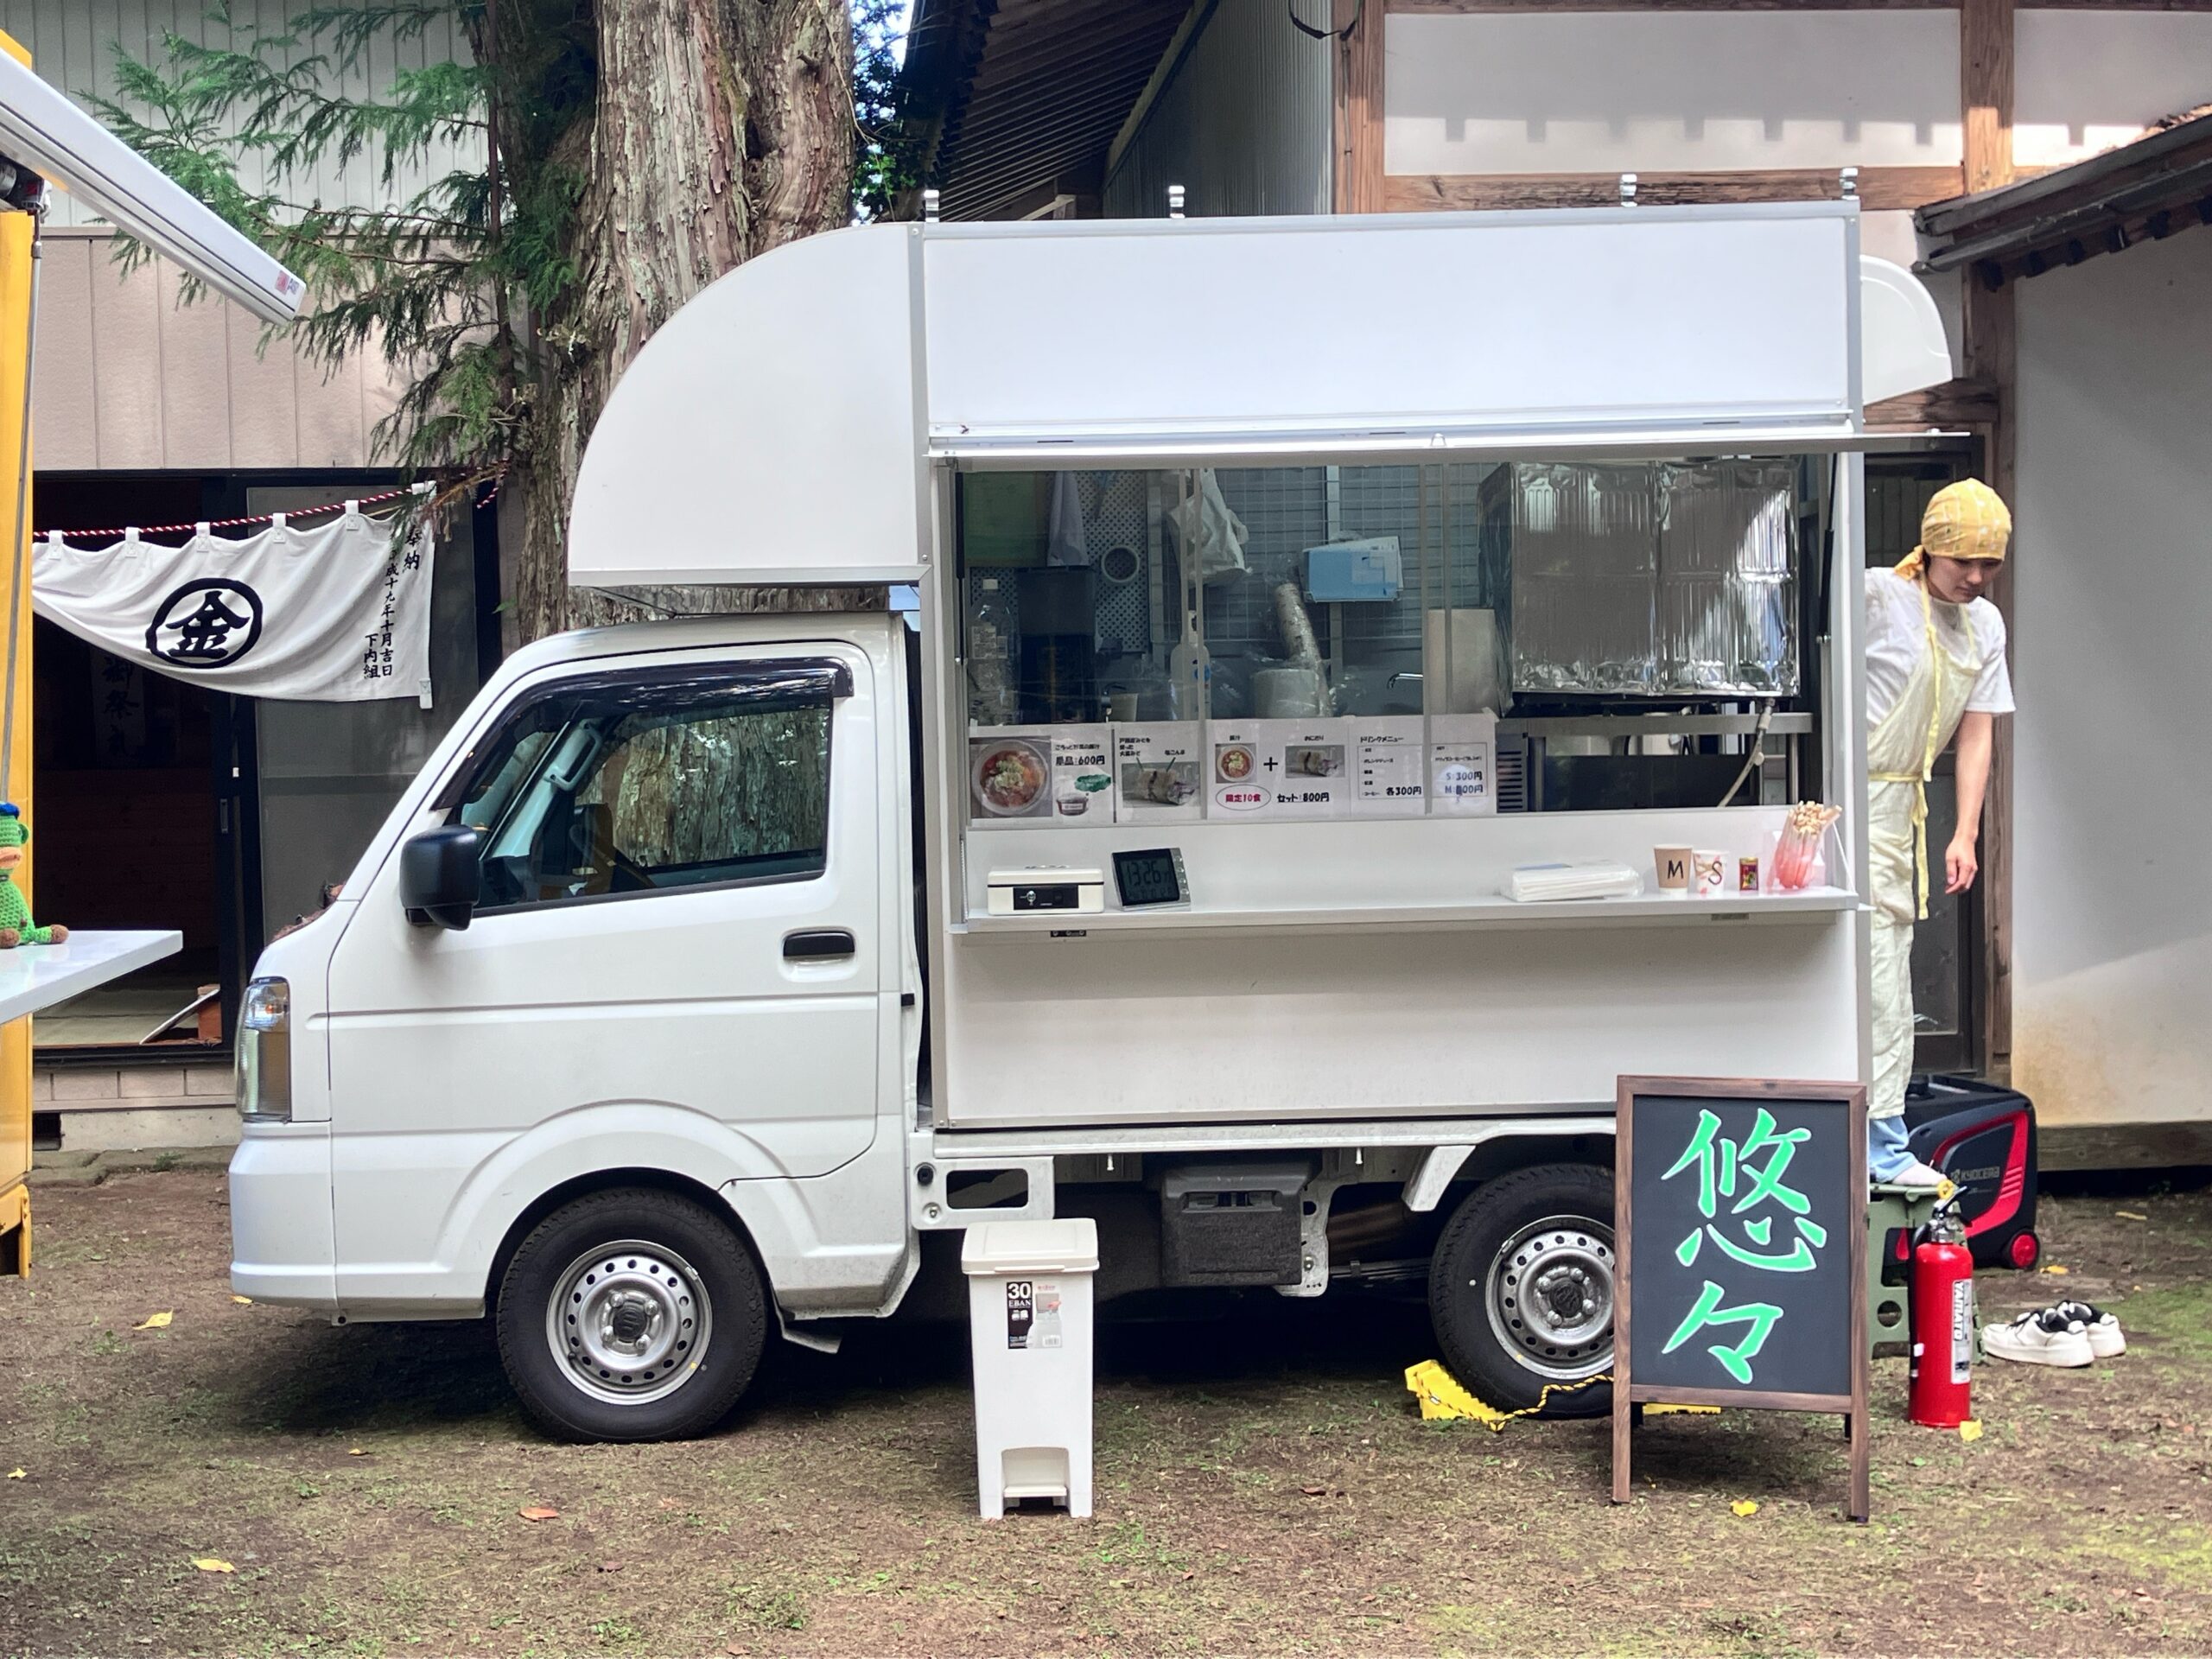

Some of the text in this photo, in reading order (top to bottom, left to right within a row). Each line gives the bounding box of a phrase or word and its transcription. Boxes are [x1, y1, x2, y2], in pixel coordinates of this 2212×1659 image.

[164, 589, 250, 659] 金
[363, 633, 381, 679] 下内組
[1668, 859, 1684, 880] M
[1708, 861, 1723, 885] S
[1007, 1282, 1032, 1300] 30
